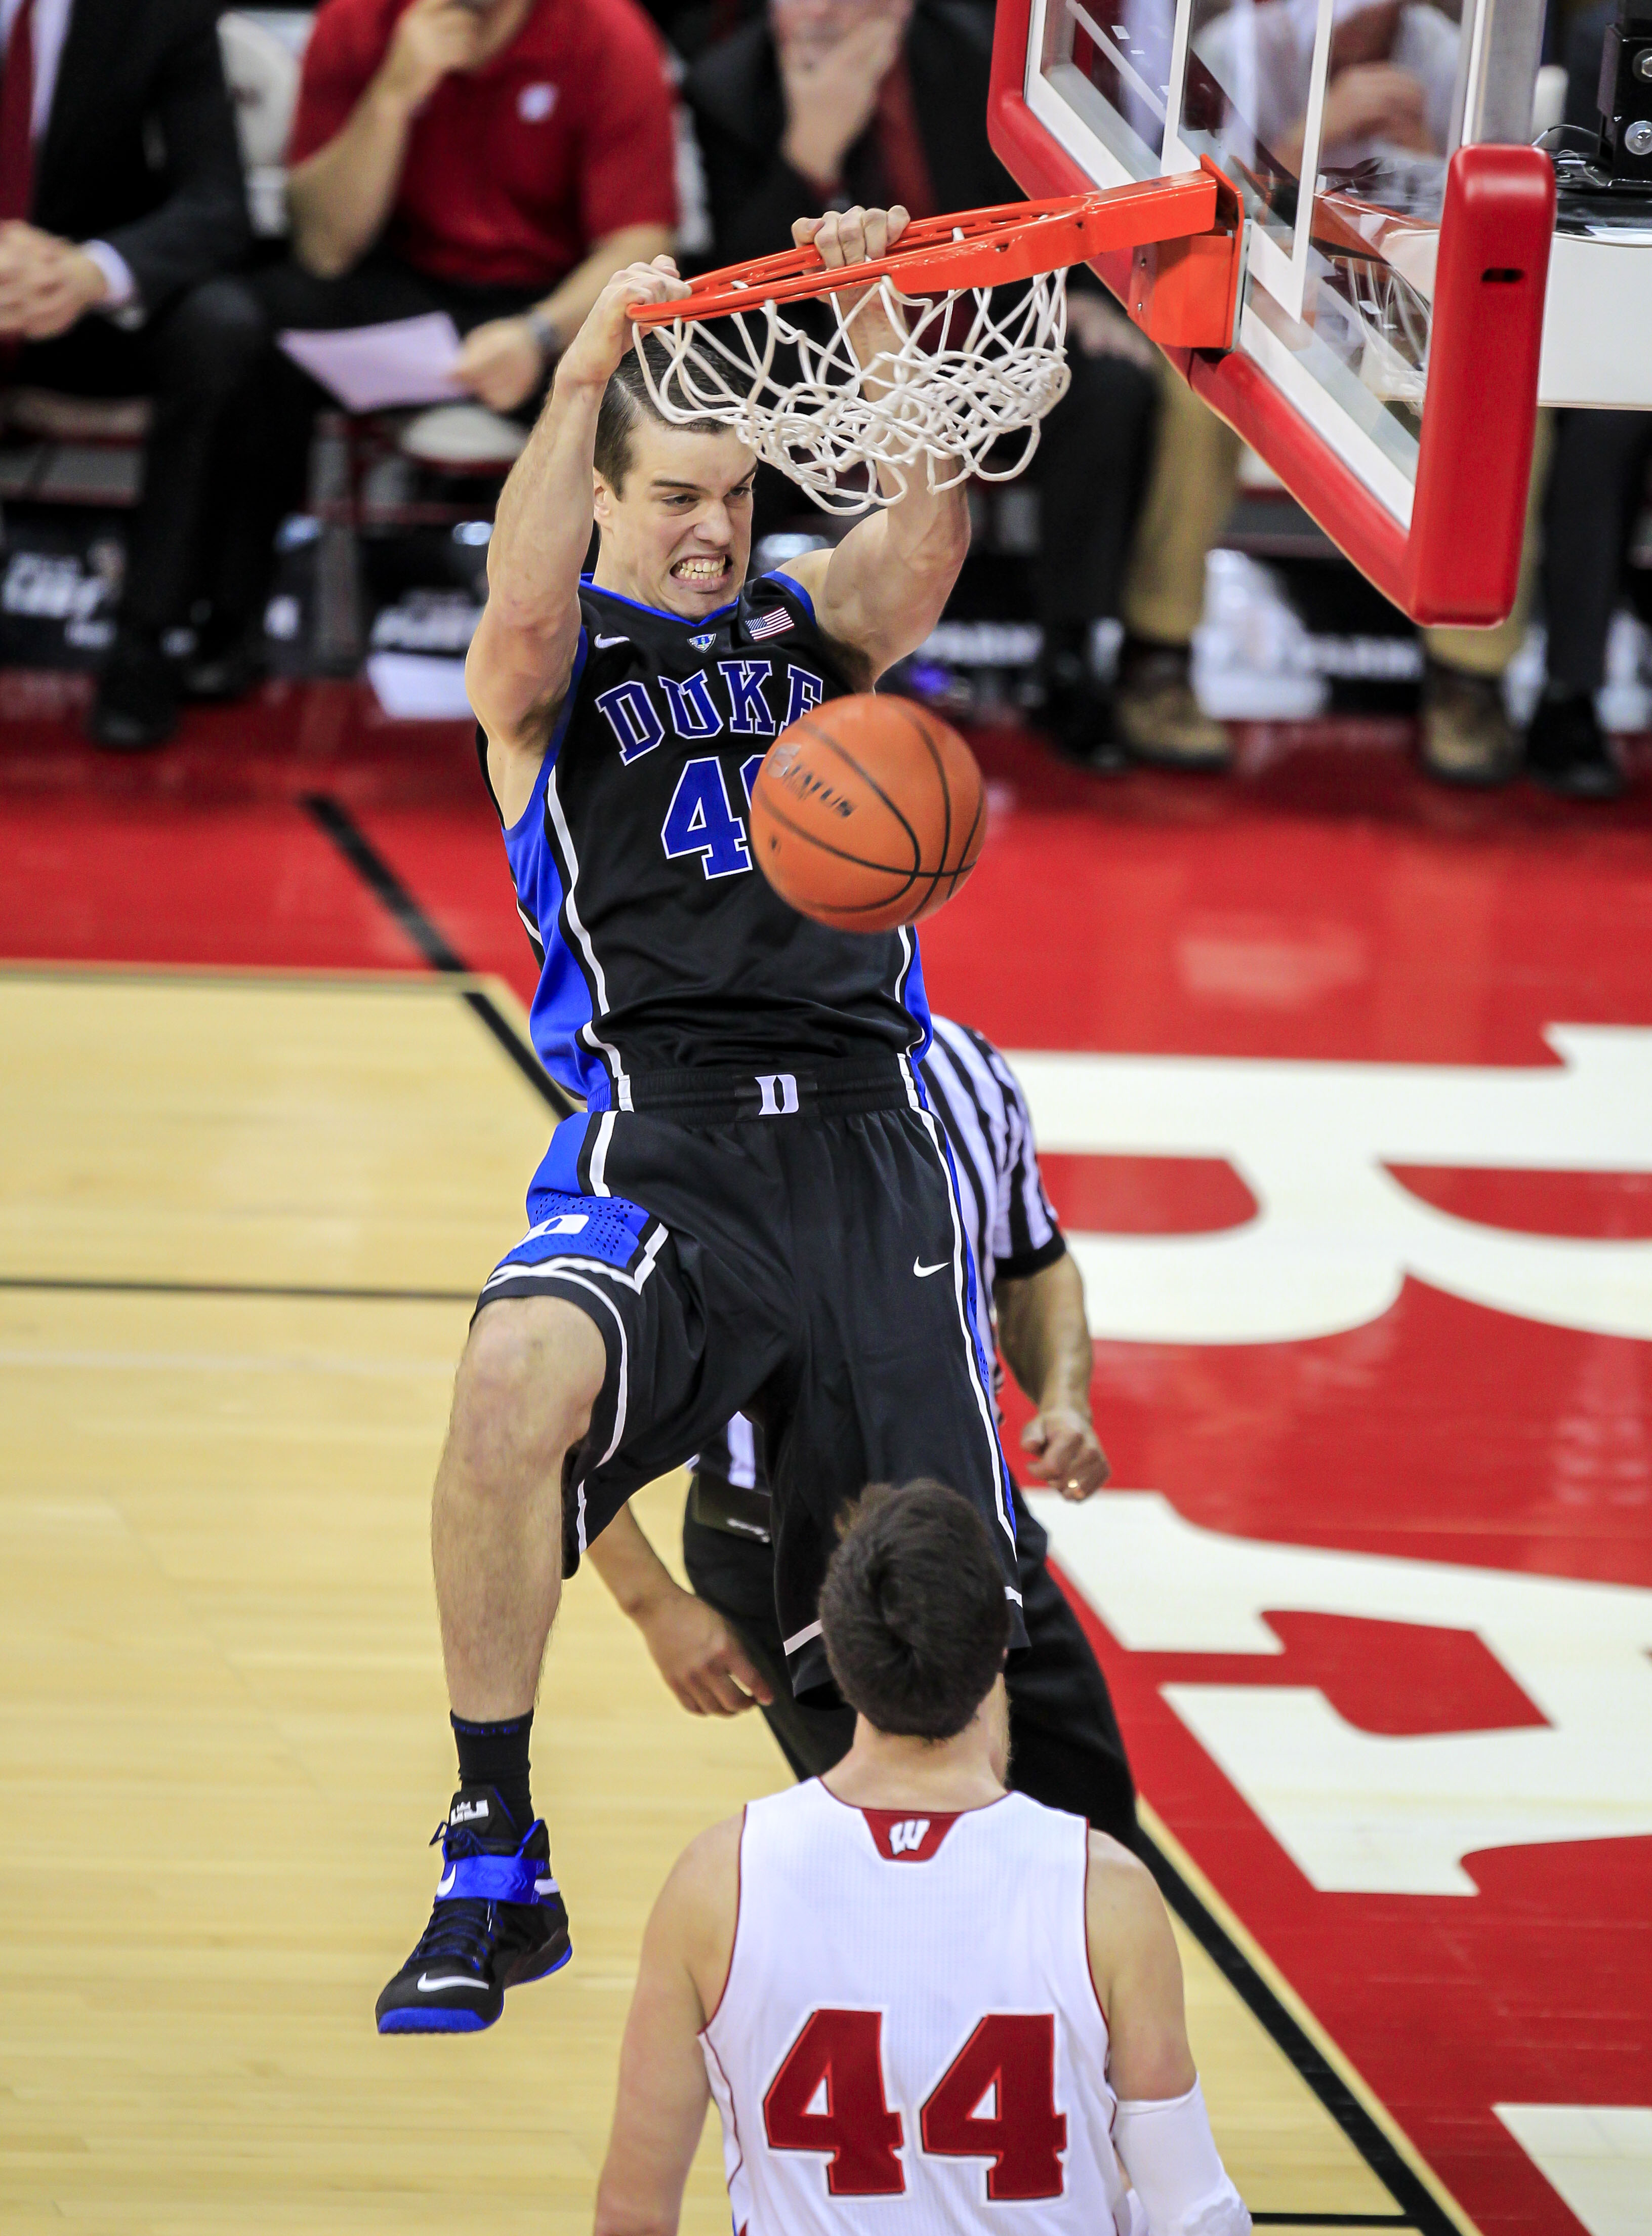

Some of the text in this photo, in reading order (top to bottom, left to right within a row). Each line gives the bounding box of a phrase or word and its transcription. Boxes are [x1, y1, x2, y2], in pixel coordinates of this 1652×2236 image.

[595, 660, 823, 766] DUKE
[754, 1074, 799, 1116] D
[889, 1818, 931, 1856] W
[763, 2009, 1067, 2200] 44
